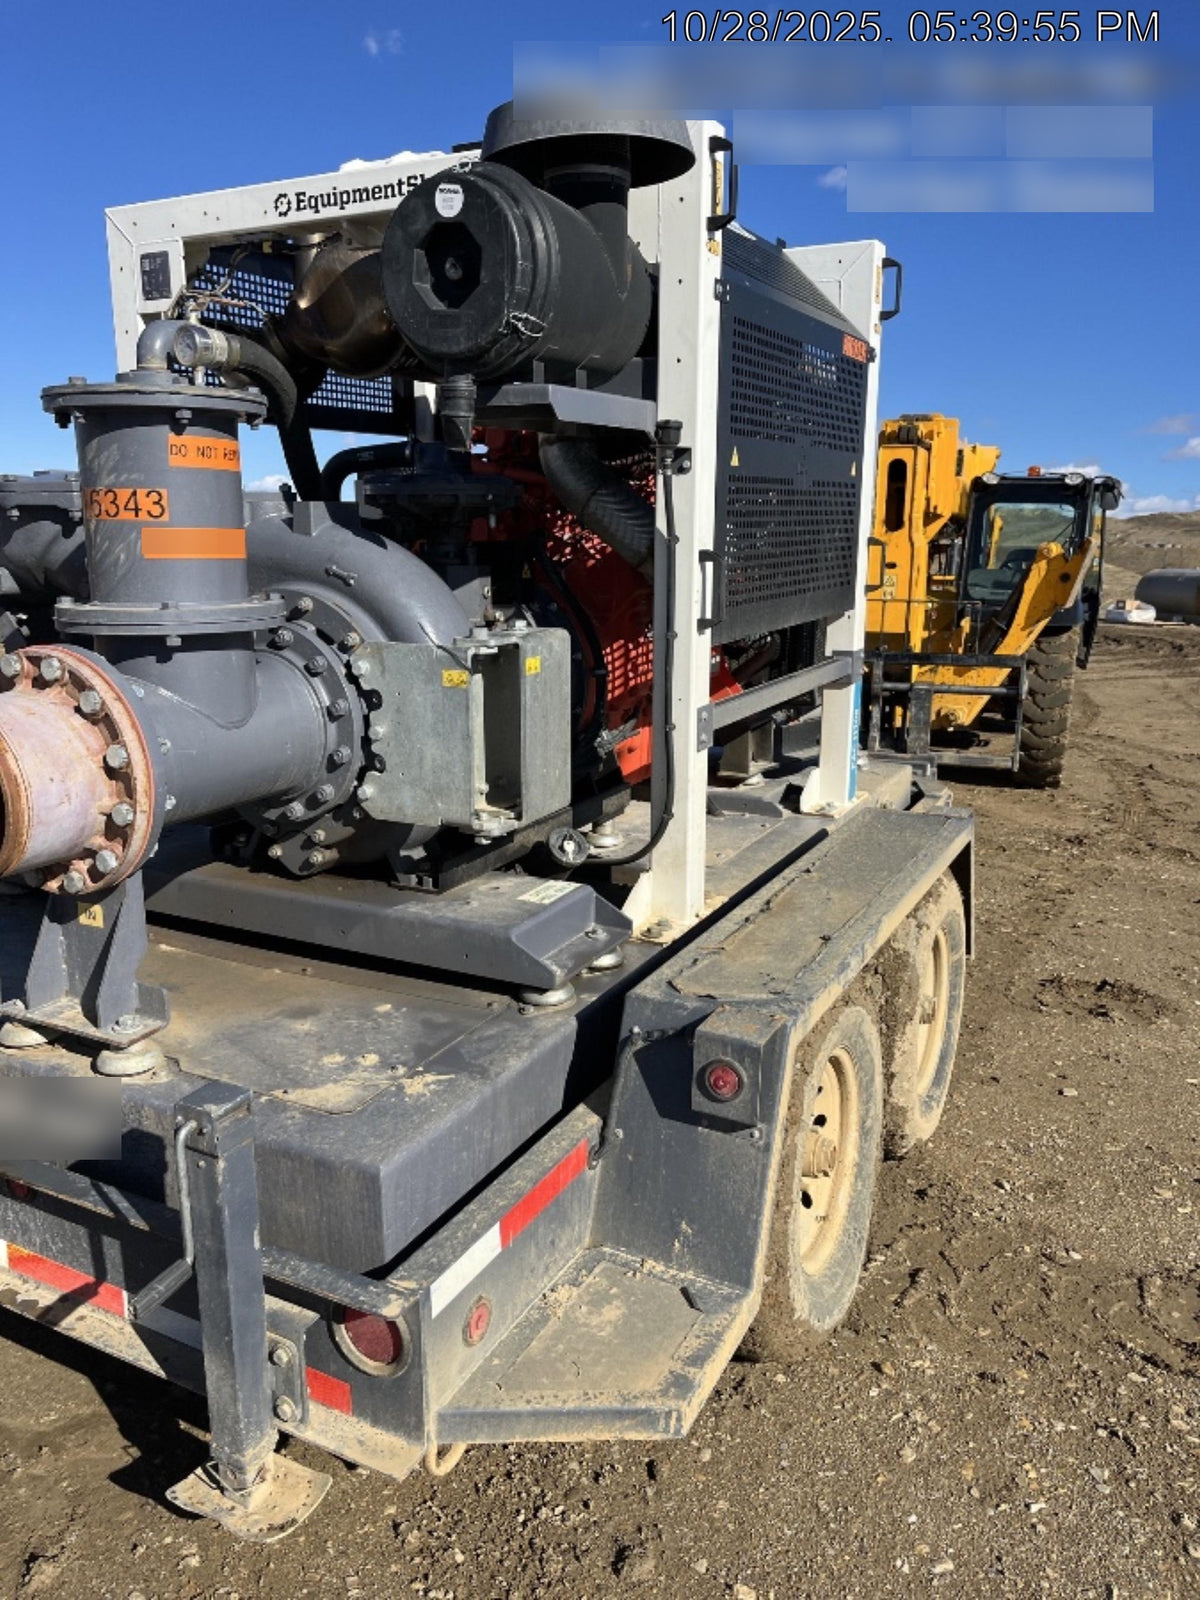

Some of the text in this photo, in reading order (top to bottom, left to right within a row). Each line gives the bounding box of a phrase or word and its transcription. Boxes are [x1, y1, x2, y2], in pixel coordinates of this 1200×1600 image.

[170, 444, 239, 461] DO NOT REM
